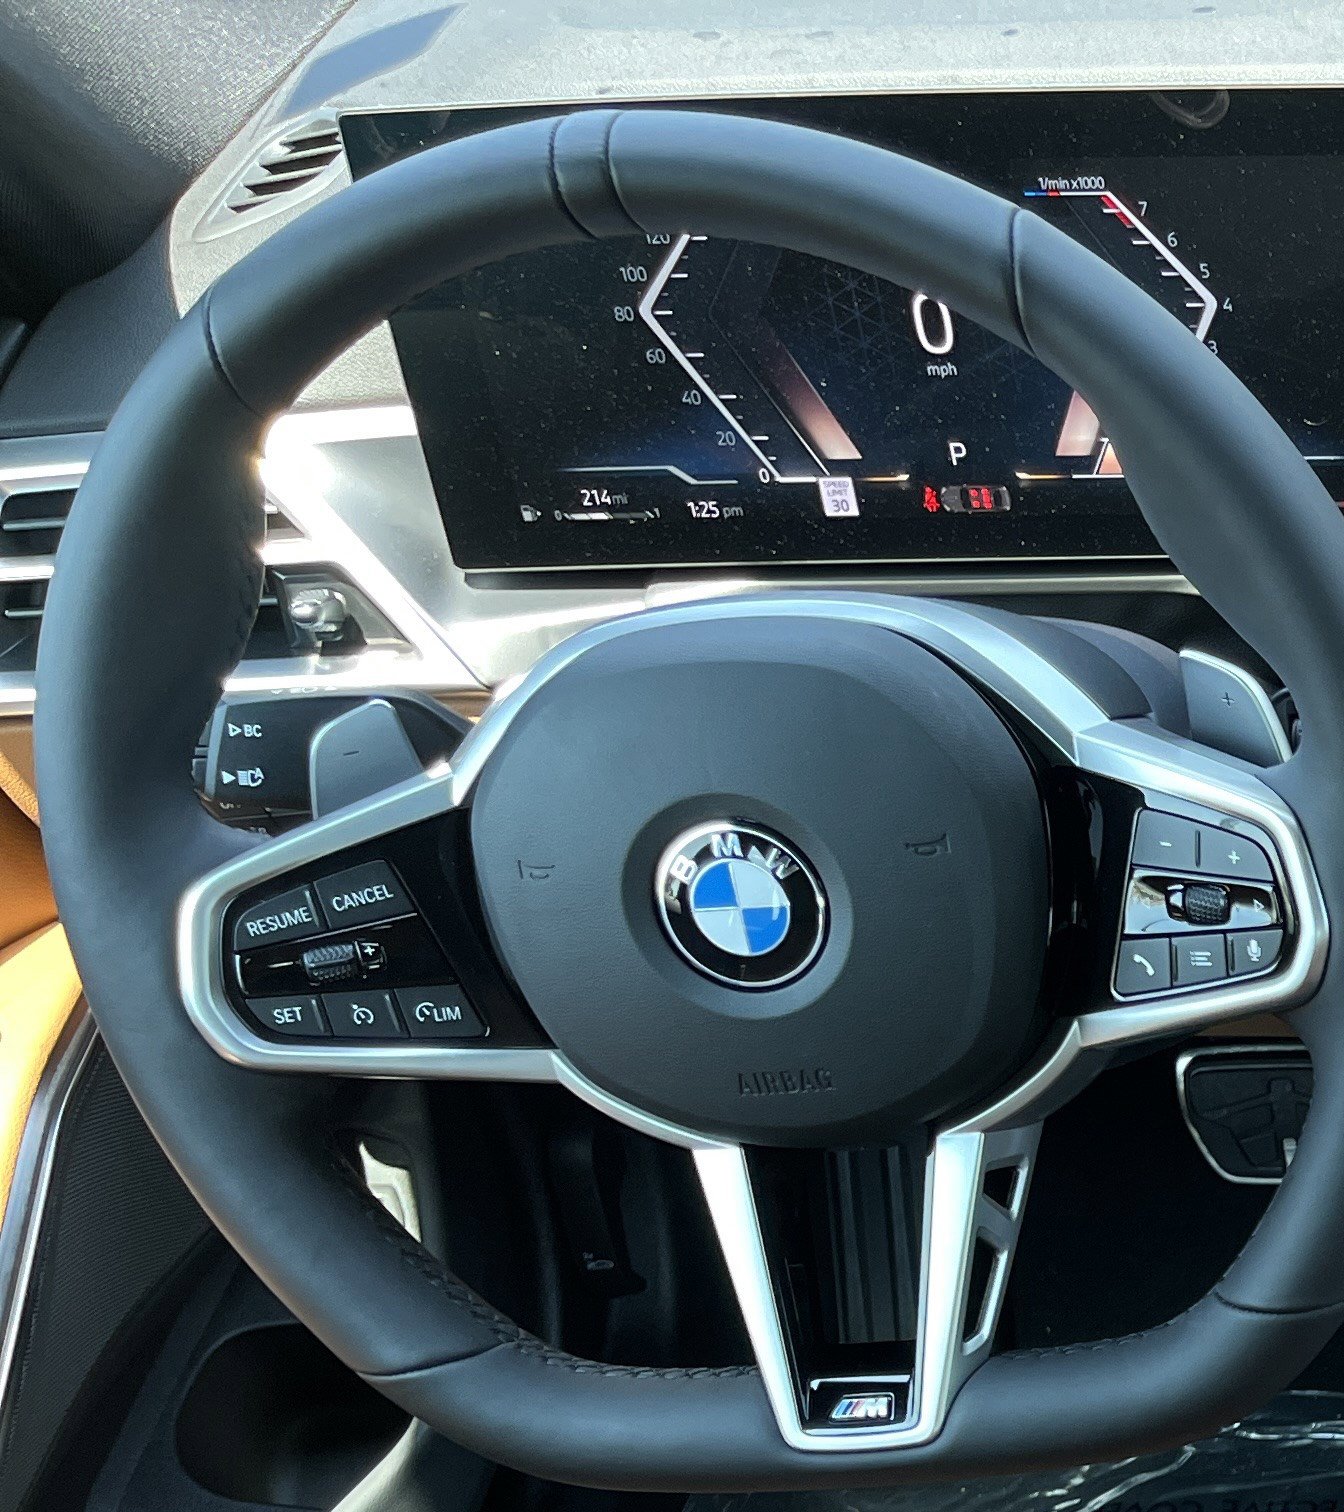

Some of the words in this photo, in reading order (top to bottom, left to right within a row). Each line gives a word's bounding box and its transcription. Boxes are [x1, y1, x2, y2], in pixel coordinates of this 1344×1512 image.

[1038, 176, 1070, 191] 1/min
[1070, 175, 1105, 190] x1000
[1137, 202, 1148, 217] 7
[1166, 232, 1178, 247] 6
[619, 266, 648, 283] 100
[1200, 264, 1211, 279] 5
[1222, 298, 1234, 313] 4
[614, 306, 635, 323] 80
[912, 292, 954, 356] 0
[645, 348, 667, 364] 60
[926, 361, 958, 380] mph
[681, 389, 702, 406] 40
[716, 430, 737, 447] 20
[949, 441, 967, 466] P
[758, 468, 771, 485] 0
[822, 480, 850, 489] SPEED
[579, 489, 611, 507] 214
[826, 489, 849, 497] LIMIT
[687, 501, 721, 519] 1:25
[722, 504, 744, 520] pm
[831, 499, 851, 513] 30
[243, 724, 263, 738] BC
[671, 832, 800, 884] BMW
[332, 883, 394, 913] CANCEL
[246, 906, 313, 938] RESUME
[273, 1006, 303, 1025] SET
[434, 1005, 462, 1021] LIM
[737, 1068, 837, 1098] AIRBAG
